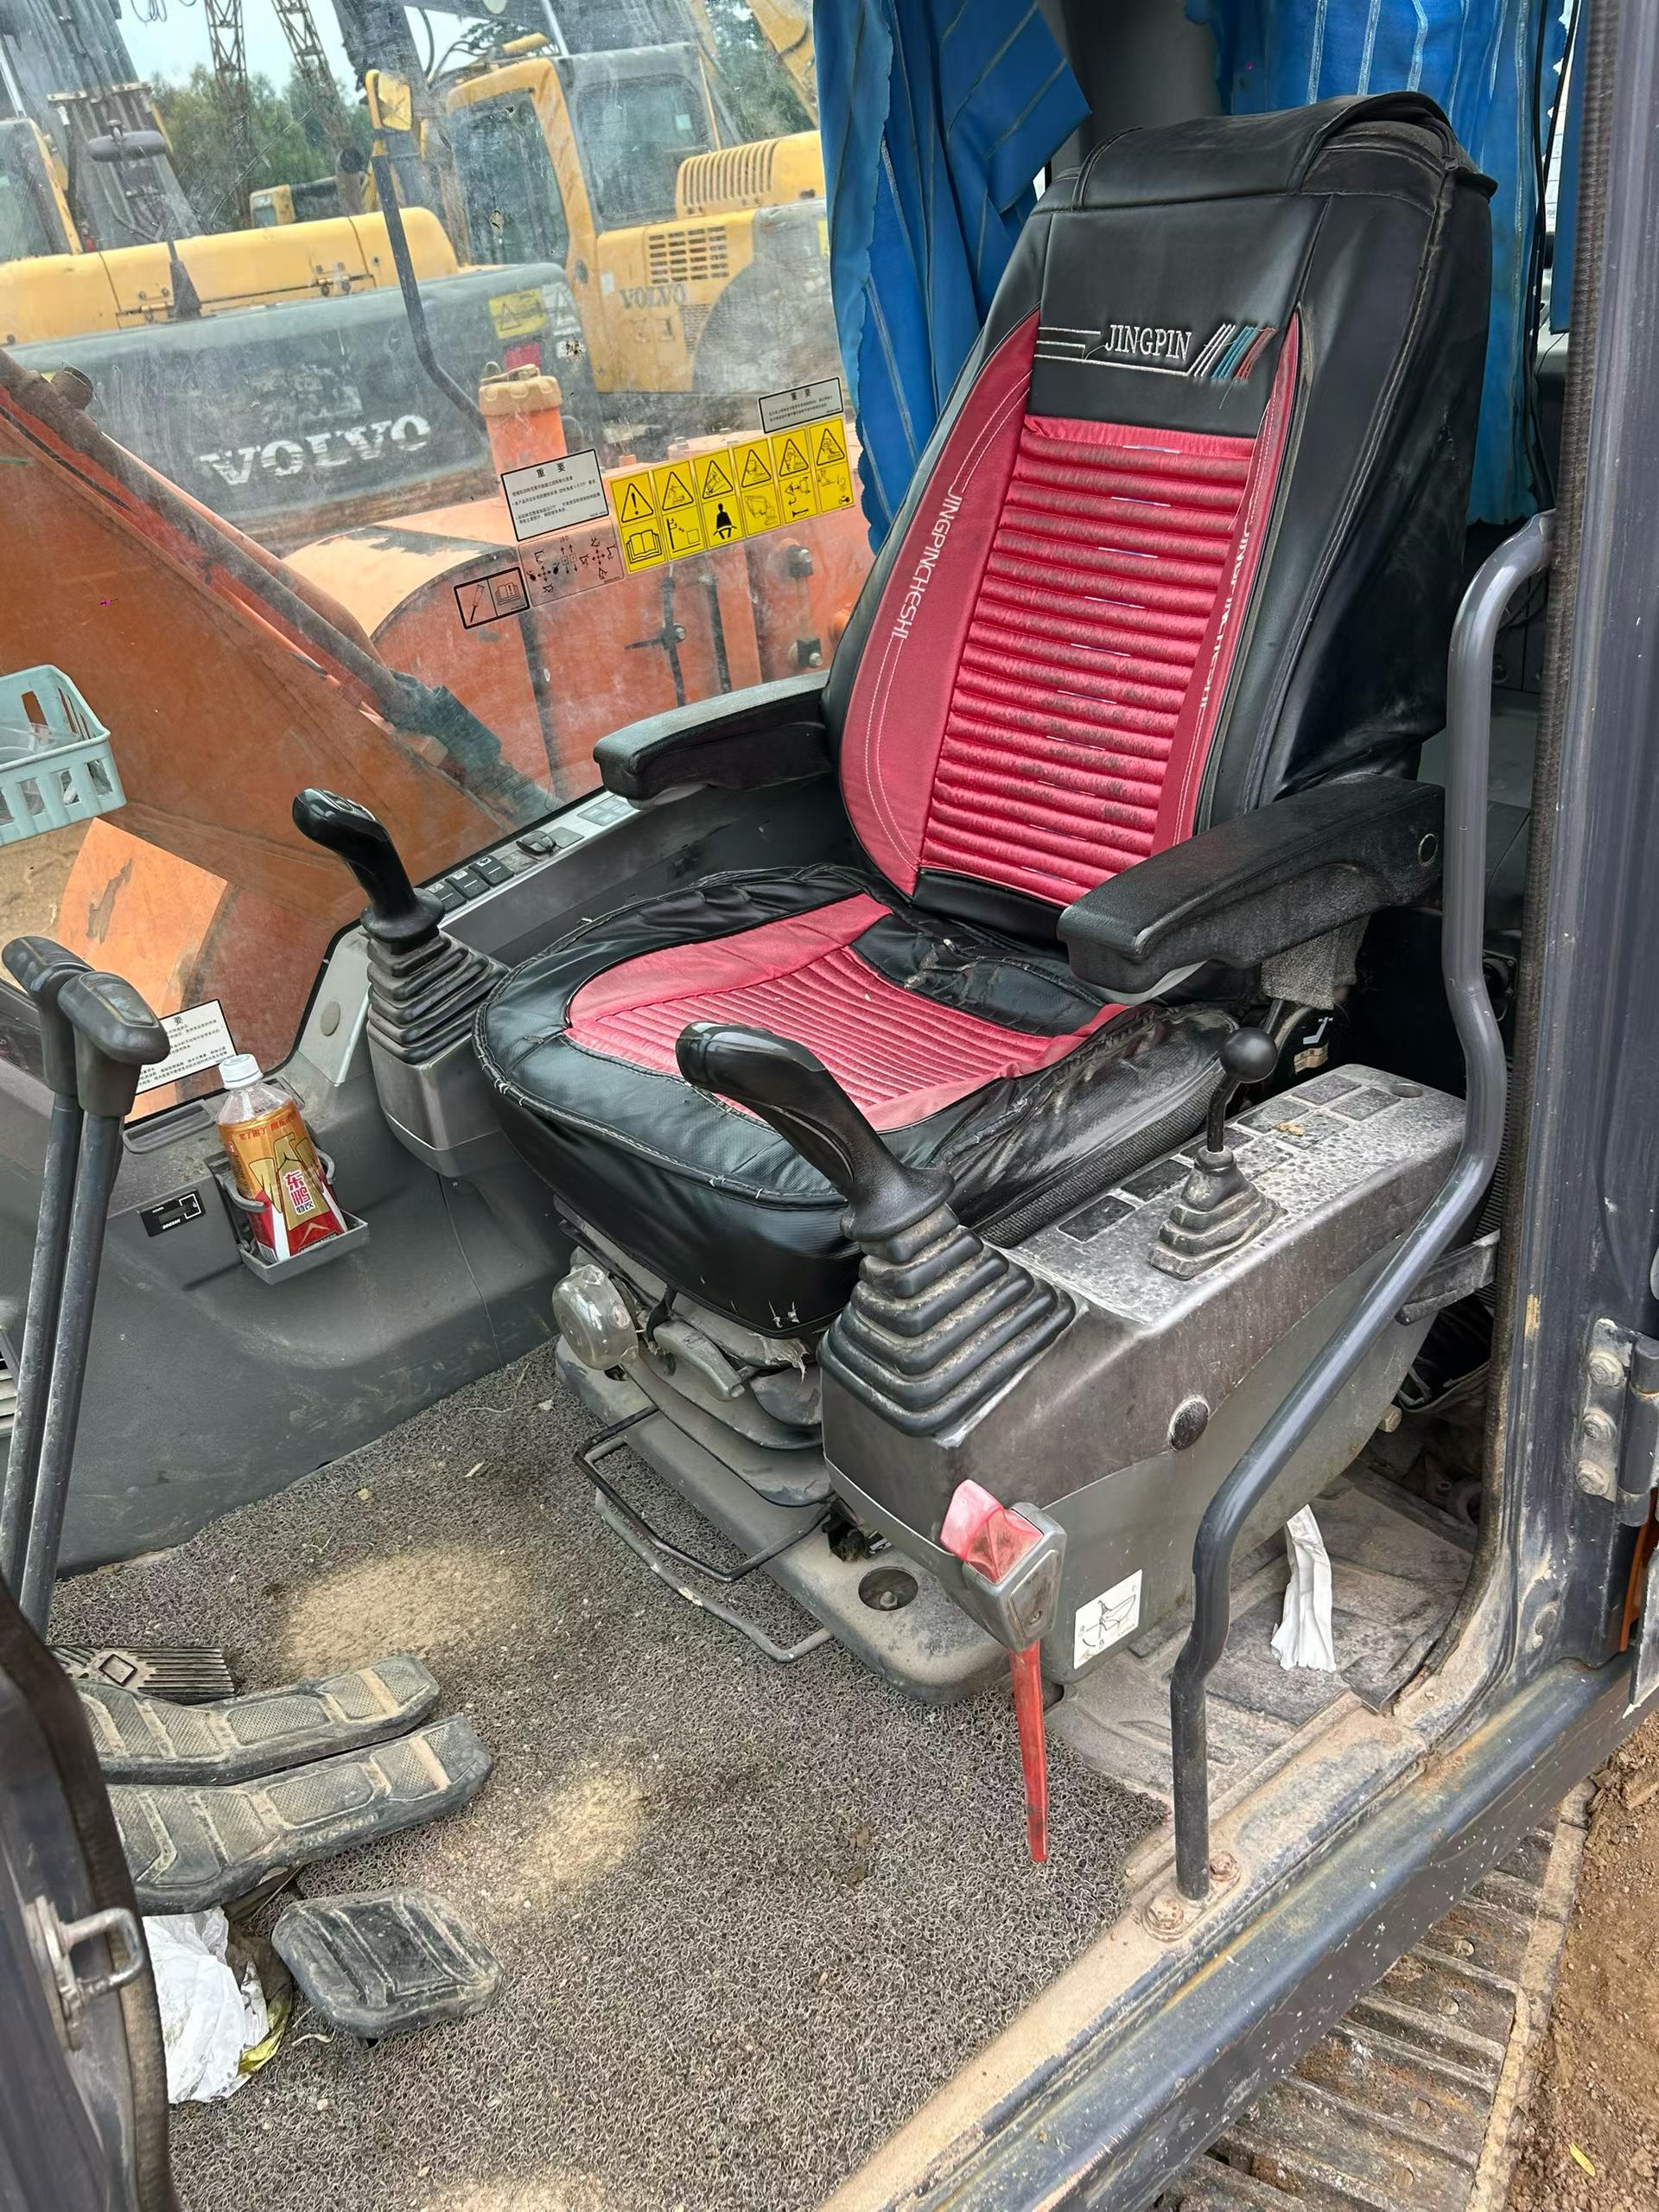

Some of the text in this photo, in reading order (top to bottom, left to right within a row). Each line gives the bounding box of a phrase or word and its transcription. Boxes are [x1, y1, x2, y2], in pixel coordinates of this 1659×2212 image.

[620, 283, 688, 309] VOLVO
[1105, 324, 1192, 361] JINGPIN
[199, 414, 431, 486] VOLVO
[892, 491, 963, 640] JINGPINCHESHI
